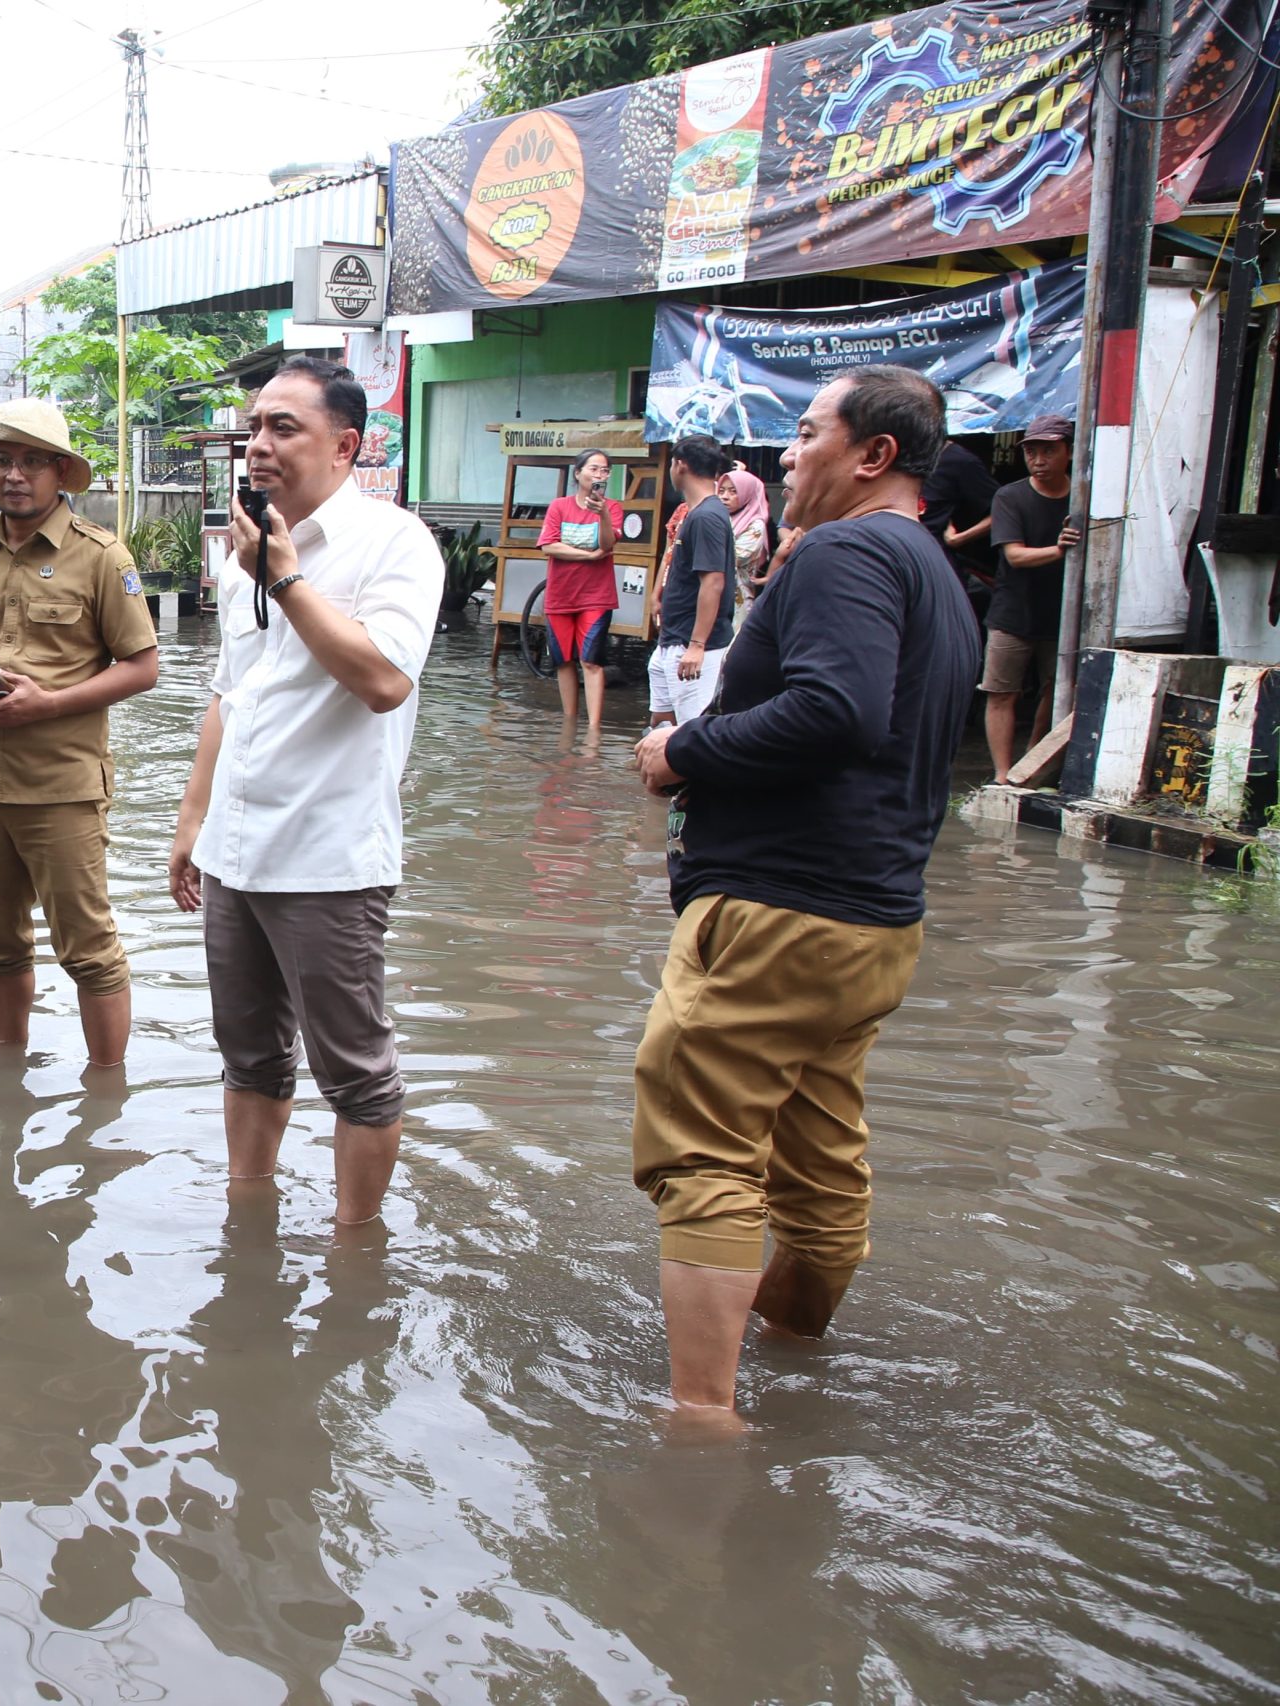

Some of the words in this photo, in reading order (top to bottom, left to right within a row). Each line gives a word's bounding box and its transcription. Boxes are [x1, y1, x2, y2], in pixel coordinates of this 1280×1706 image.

[922, 77, 997, 108] SERVICE
[998, 71, 1016, 89] &
[826, 82, 1081, 180] BJMTECH
[478, 168, 576, 204] CANGKRUK'AN
[828, 165, 957, 204] PERFORMANCE
[673, 185, 752, 221] AYAM
[501, 214, 538, 236] KOPI
[687, 231, 746, 256] Semet
[489, 256, 539, 284] BJM
[667, 271, 684, 284] GO
[699, 264, 736, 280] FOOD
[338, 286, 364, 297] Kopi
[343, 299, 357, 309] BJM
[723, 317, 781, 339] BJM
[751, 341, 810, 359] Service
[813, 337, 828, 355] &
[831, 336, 894, 356] Remap
[898, 327, 940, 349] ECU
[810, 356, 843, 367] (HONDA
[843, 353, 871, 365] ONLY)
[505, 430, 524, 447] SOTO
[525, 430, 555, 447] DAGING
[556, 433, 564, 447] &
[355, 466, 398, 490] YAM
